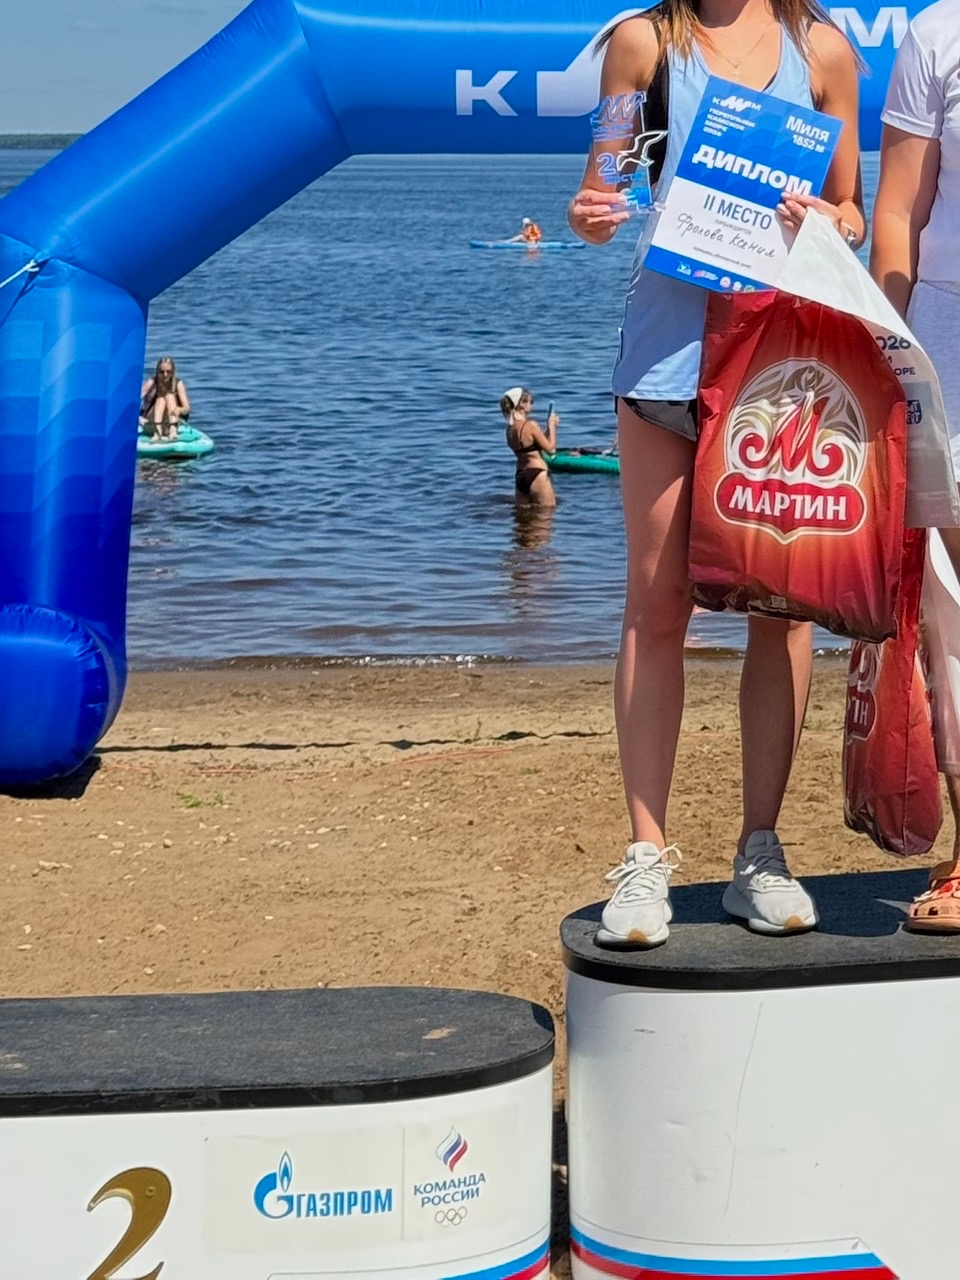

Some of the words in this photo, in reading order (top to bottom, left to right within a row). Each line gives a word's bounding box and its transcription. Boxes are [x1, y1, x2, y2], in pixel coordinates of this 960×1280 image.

[785, 115, 830, 142] Миля
[792, 134, 817, 151] 1852
[691, 144, 813, 195] ДИПЛОМ
[717, 201, 772, 230] МЕСТО
[875, 334, 912, 351] 026
[893, 367, 916, 376] ОРЕ
[729, 484, 847, 521] МАРТИН
[413, 1173, 487, 1197] КОМАНДА
[421, 1187, 481, 1208] РОССИИ
[295, 1187, 394, 1219] ГАЗПРОМ
[86, 1166, 173, 1280] 2
